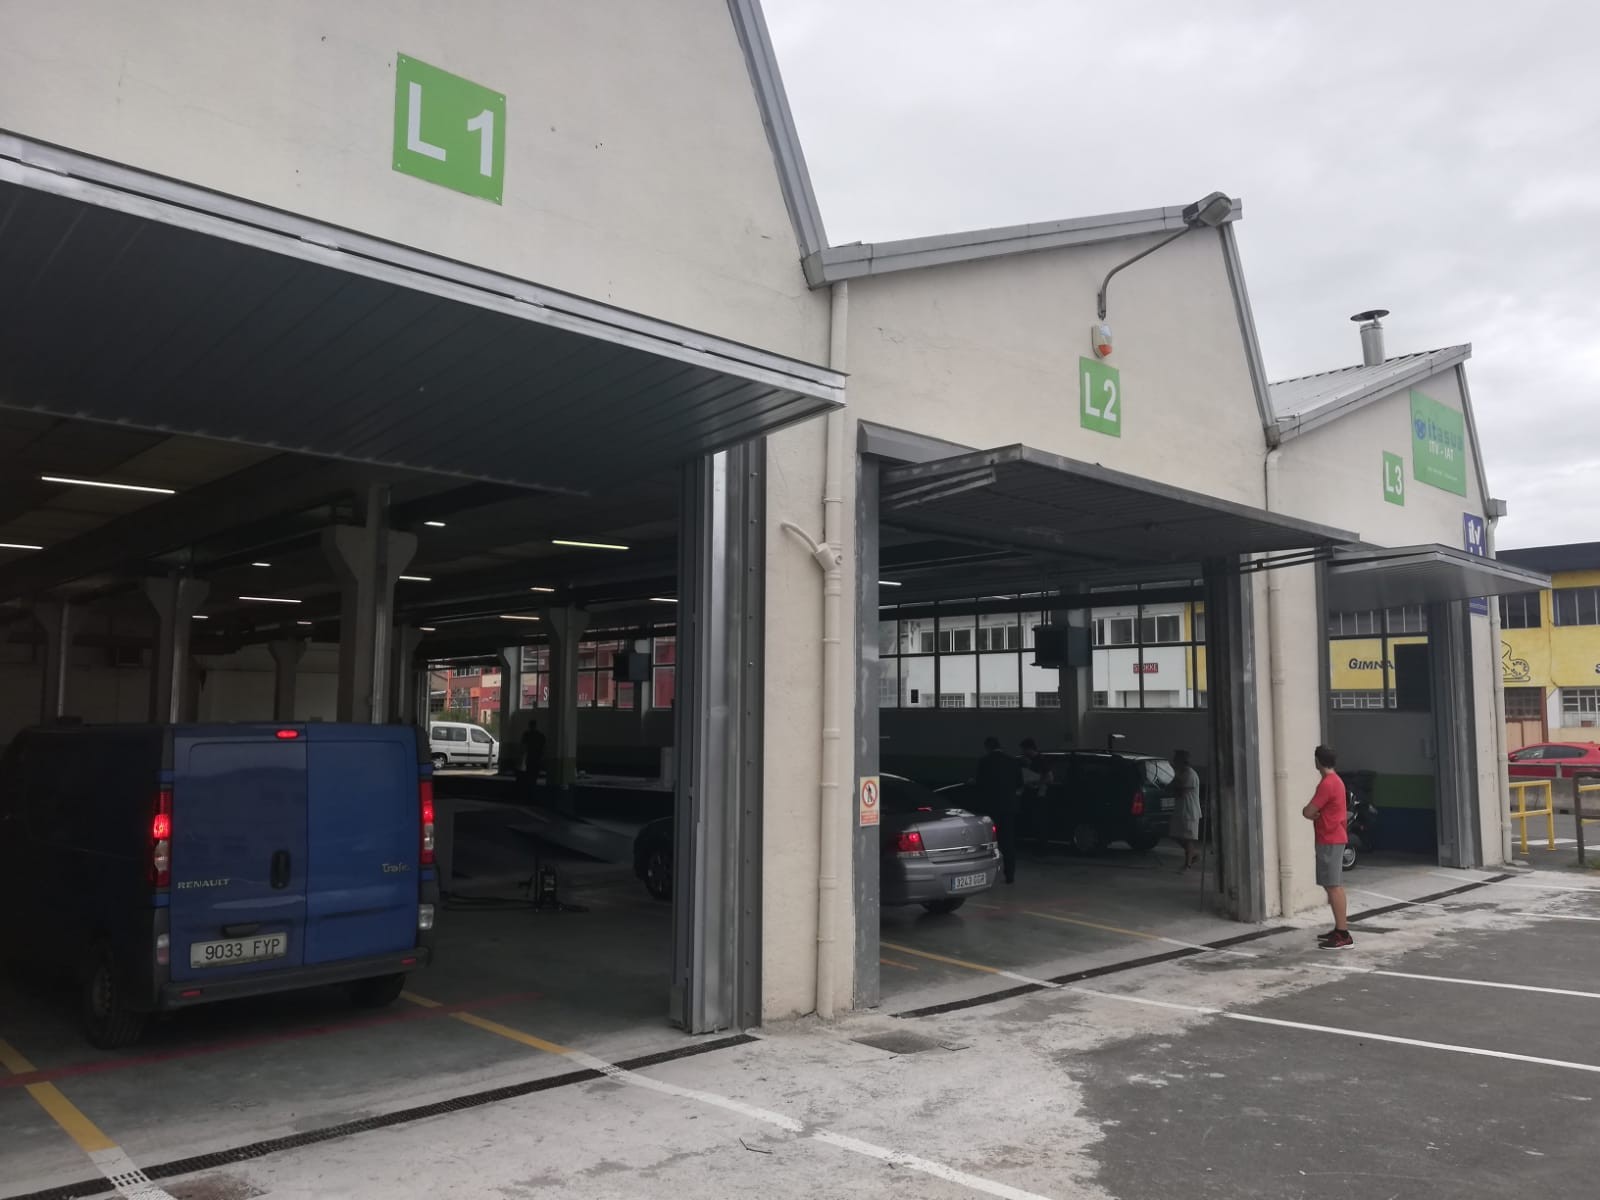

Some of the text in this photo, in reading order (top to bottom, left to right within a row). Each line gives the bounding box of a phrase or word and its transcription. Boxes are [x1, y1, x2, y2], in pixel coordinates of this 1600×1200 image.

[1085, 372, 1117, 422] L2
[1385, 460, 1403, 495] L3
[177, 878, 231, 890] RENAULT
[204, 938, 281, 960] 9033 FYP
